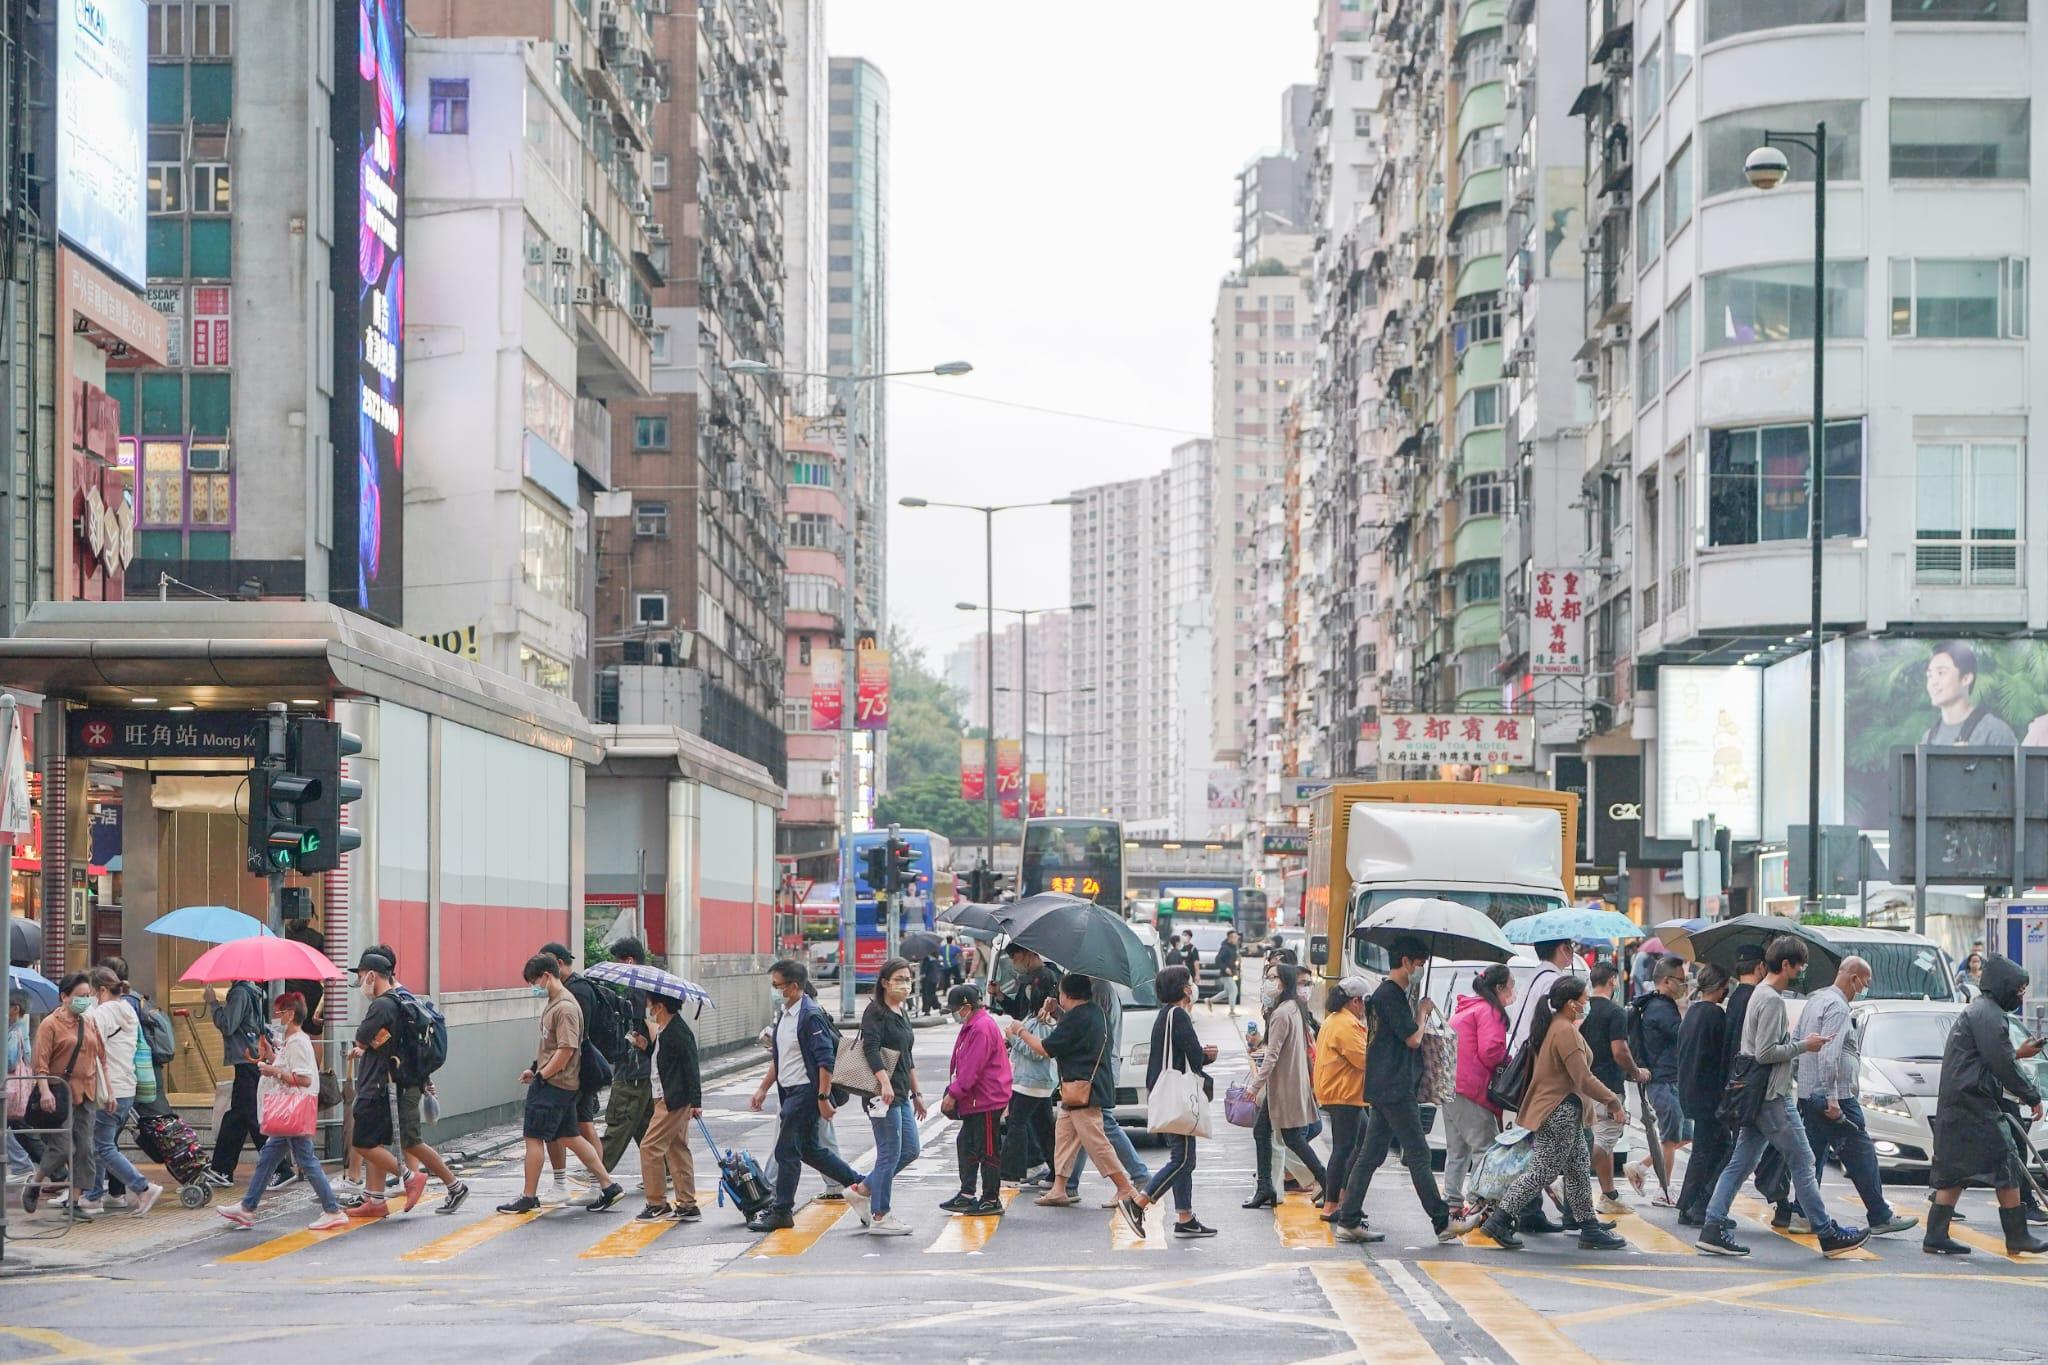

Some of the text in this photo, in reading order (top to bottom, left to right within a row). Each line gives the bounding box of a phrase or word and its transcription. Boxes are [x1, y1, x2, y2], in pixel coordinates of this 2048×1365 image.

[147, 288, 180, 300] ESCAPE
[151, 301, 176, 312] GAME
[420, 625, 477, 655] o!
[125, 724, 198, 747] 旺角站
[202, 733, 241, 749] Mong
[1393, 716, 1520, 742] 皇都賓館
